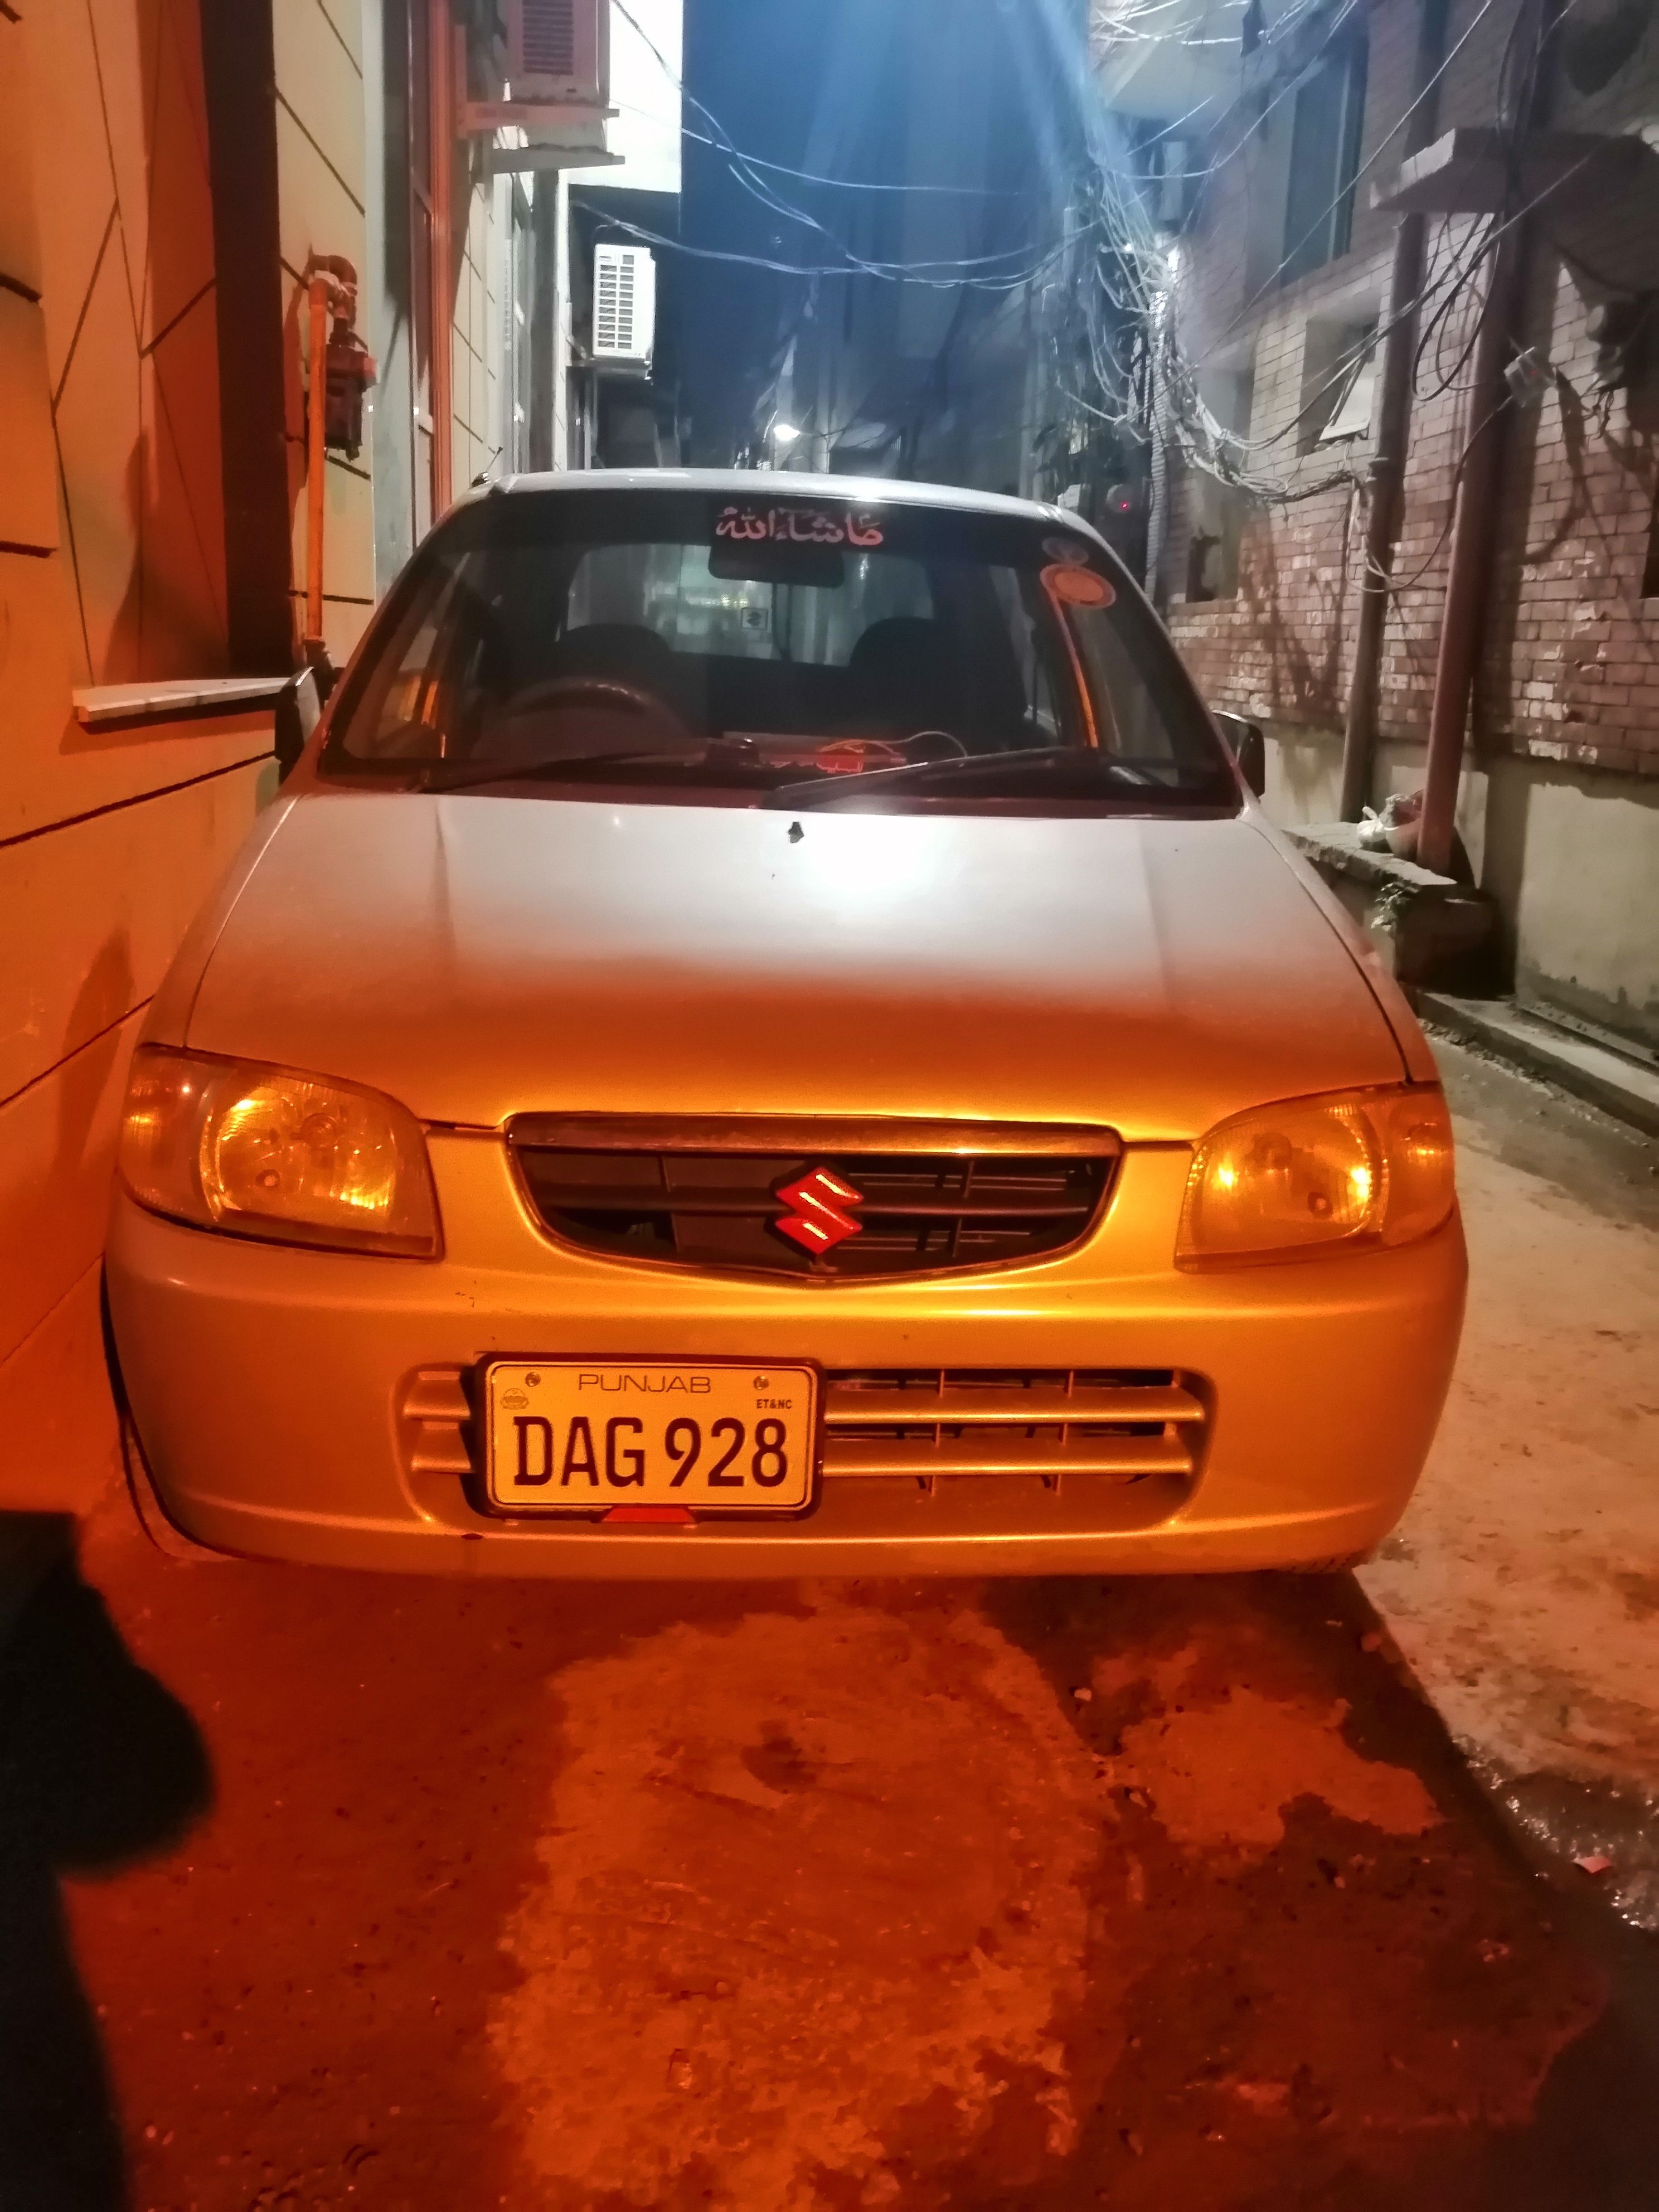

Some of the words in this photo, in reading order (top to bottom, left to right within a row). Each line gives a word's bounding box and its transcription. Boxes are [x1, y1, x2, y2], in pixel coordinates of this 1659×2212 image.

[578, 1374, 711, 1394] PUNJAB
[756, 1398, 793, 1409] ET&NC
[513, 1415, 645, 1487] DAG
[664, 1417, 788, 1487] 928
